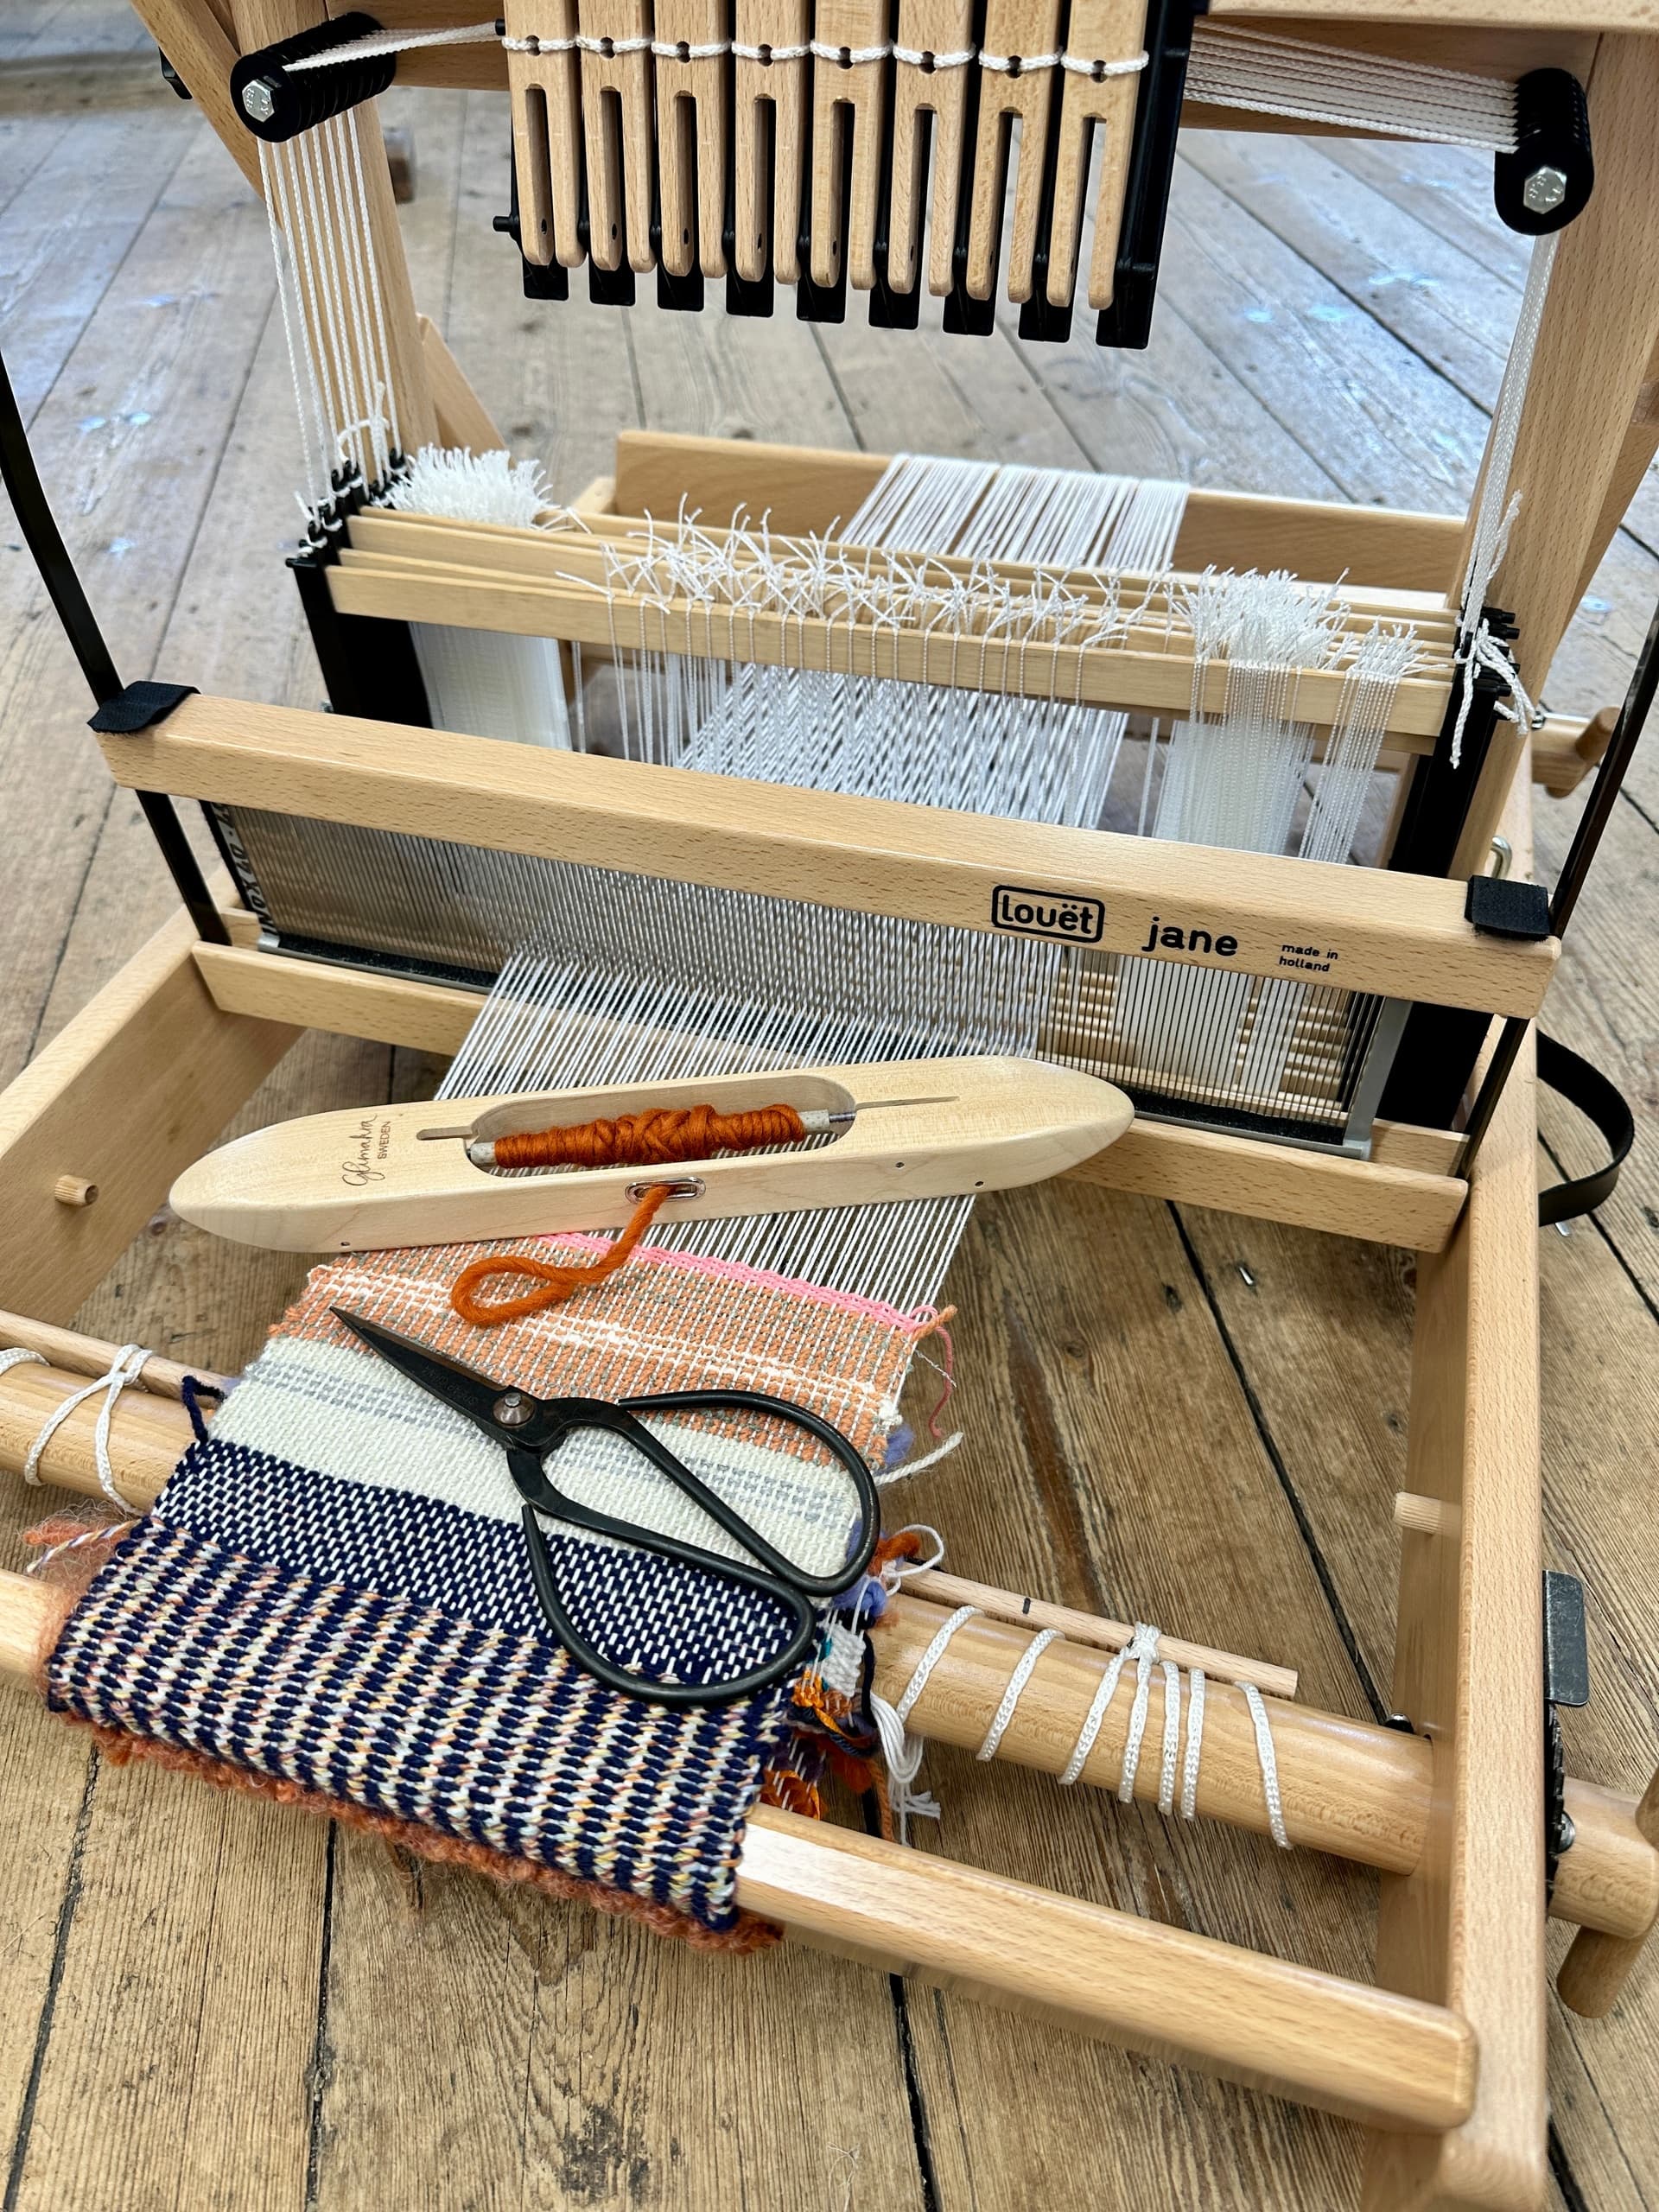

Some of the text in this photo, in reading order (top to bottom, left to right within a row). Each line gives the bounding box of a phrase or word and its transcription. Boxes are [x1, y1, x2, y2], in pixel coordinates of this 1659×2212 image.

[1002, 894, 1093, 934] louët
[1141, 916, 1238, 957] jane
[1281, 944, 1338, 960] made in
[1279, 956, 1330, 972] holland
[378, 1121, 391, 1160] SWEDEN
